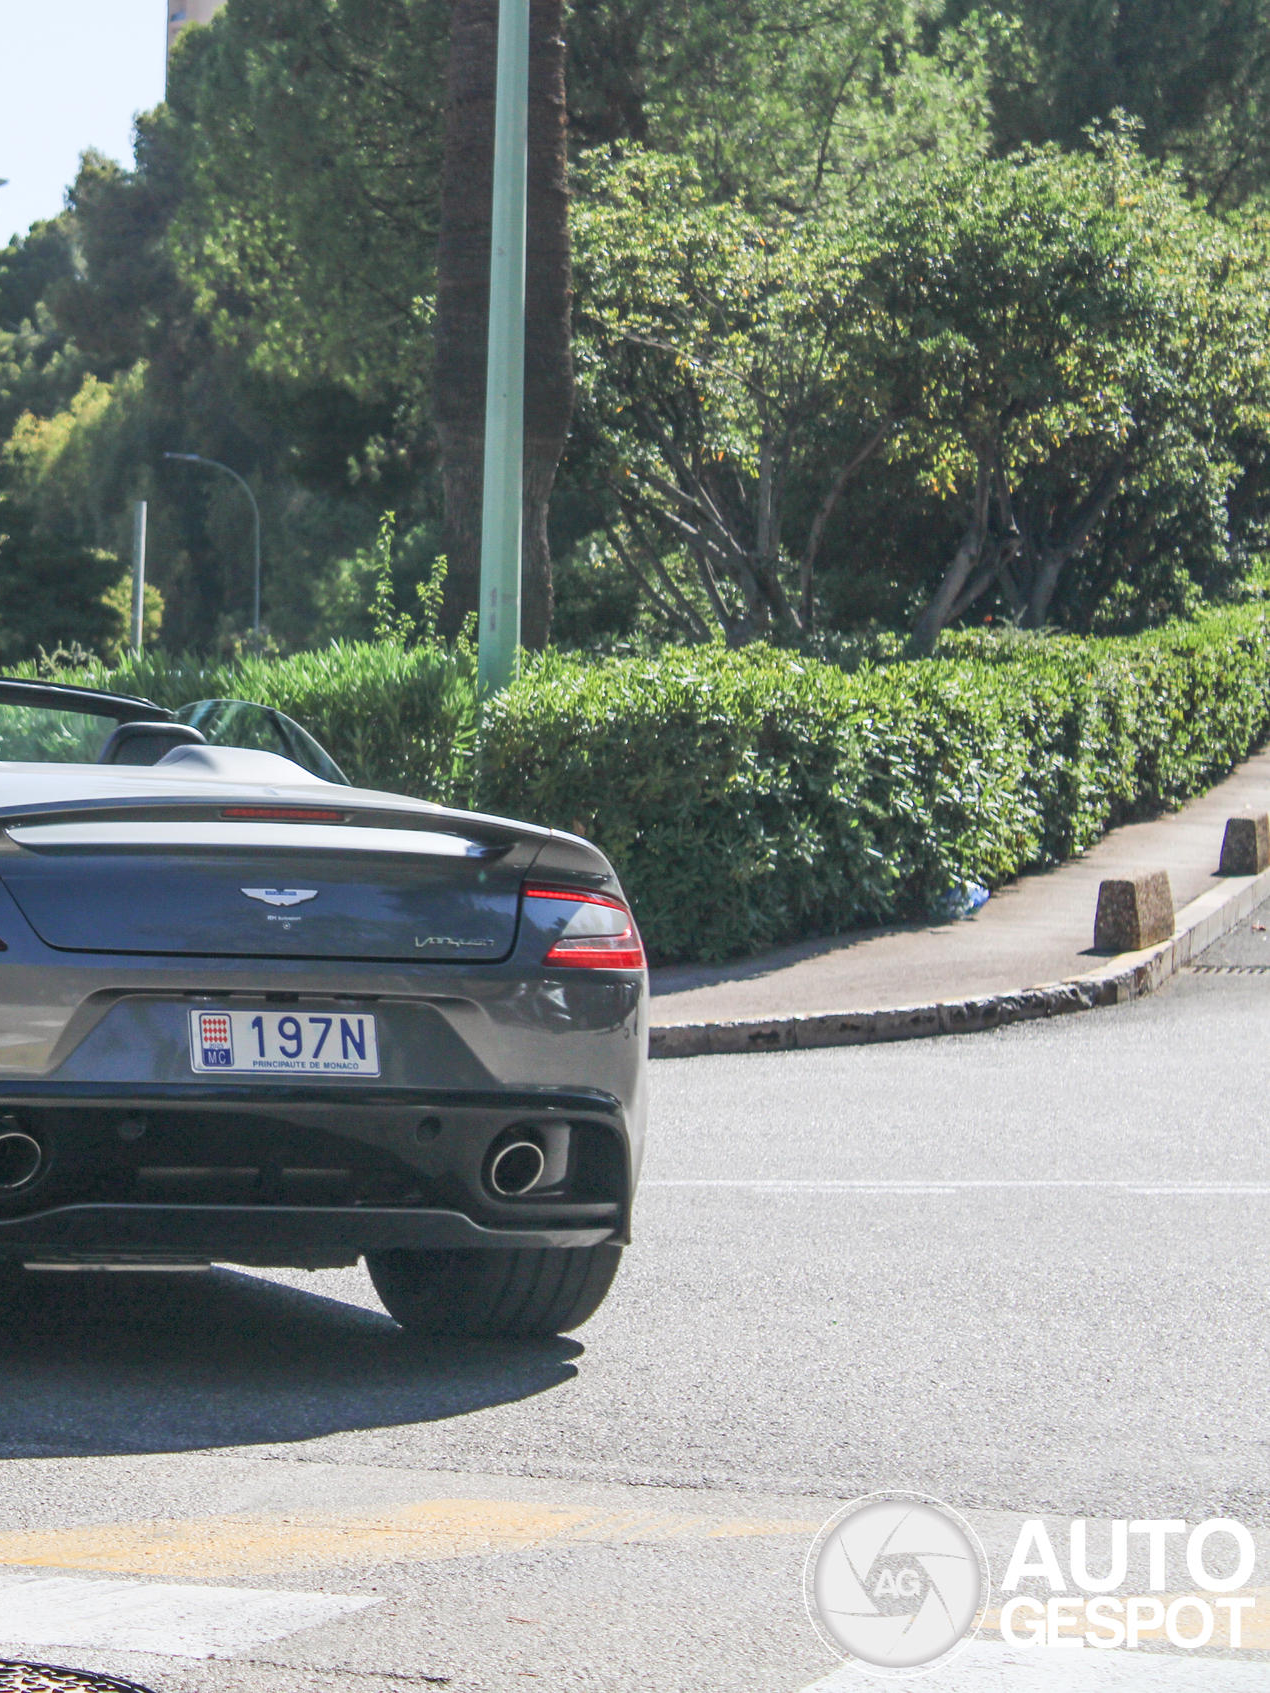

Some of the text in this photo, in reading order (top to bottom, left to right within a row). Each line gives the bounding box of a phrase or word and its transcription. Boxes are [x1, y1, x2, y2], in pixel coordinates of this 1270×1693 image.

[251, 1015, 367, 1061] 197N
[208, 1050, 226, 1065] MC
[252, 1060, 359, 1070] PRINCIPAUTE DE MONACO
